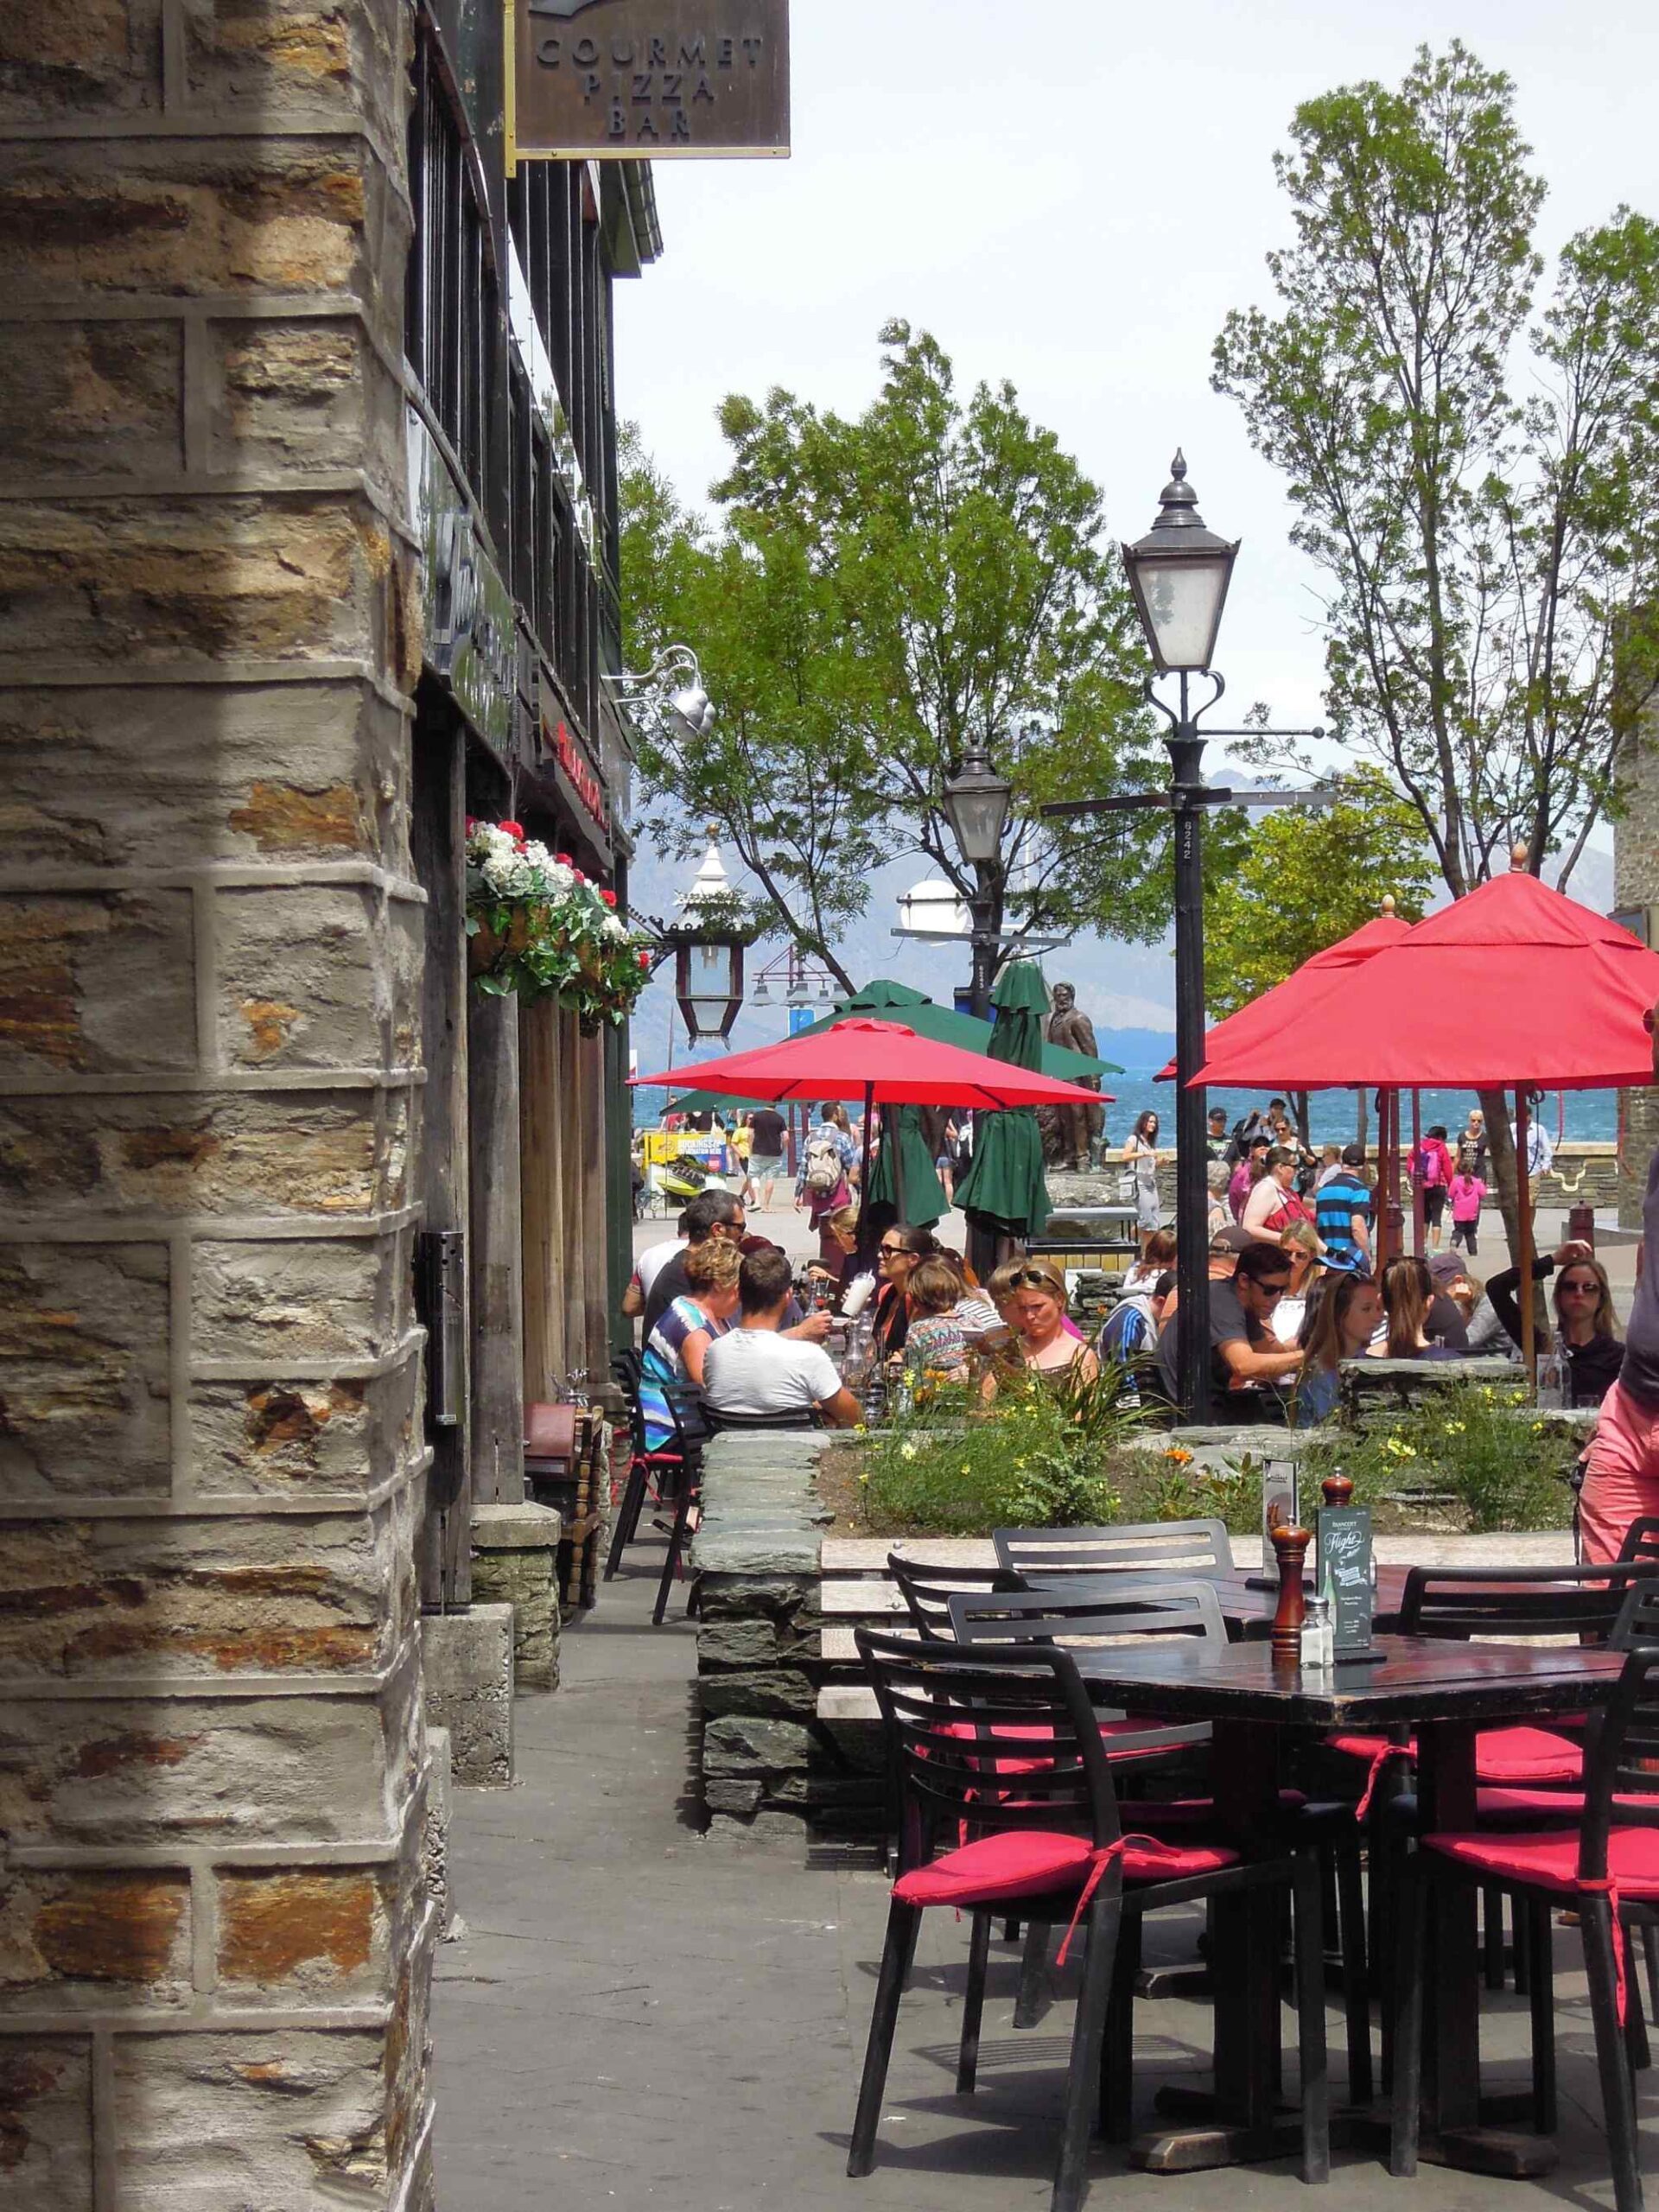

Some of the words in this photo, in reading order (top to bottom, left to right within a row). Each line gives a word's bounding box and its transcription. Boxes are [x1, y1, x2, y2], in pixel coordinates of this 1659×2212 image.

[537, 36, 764, 67] GOURMET
[583, 69, 714, 102] PIZZA
[607, 105, 690, 139] BAR
[1324, 1530, 1365, 1554] Flight
